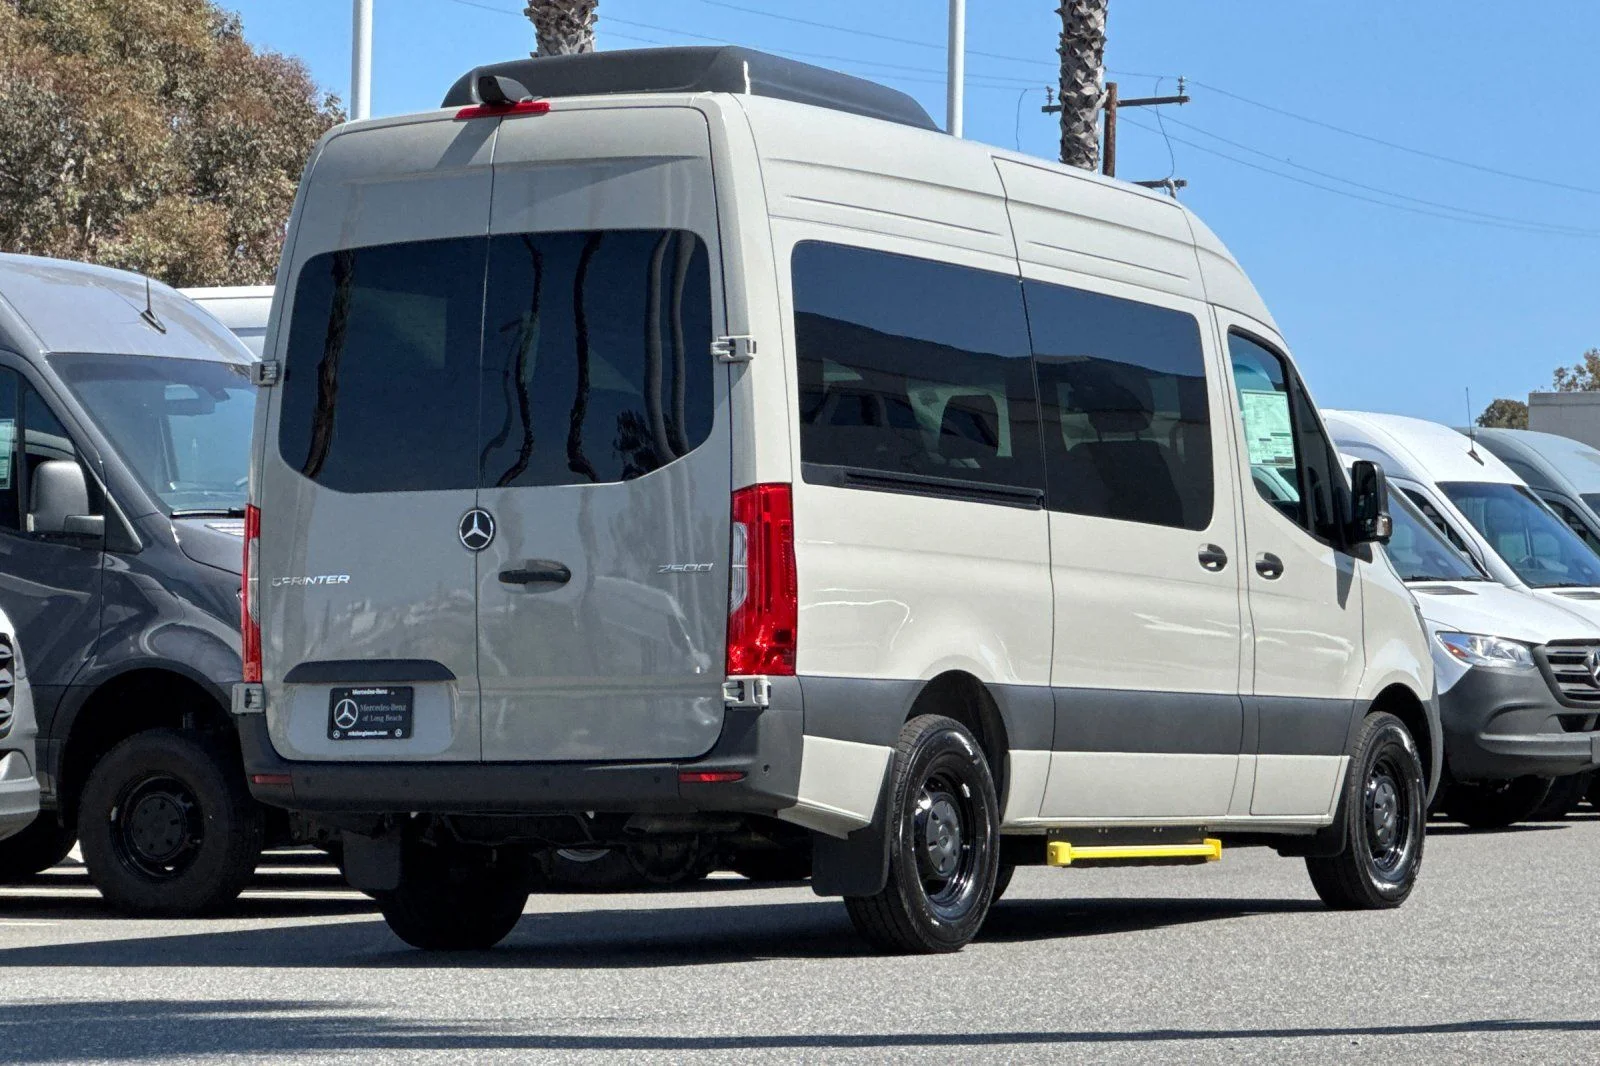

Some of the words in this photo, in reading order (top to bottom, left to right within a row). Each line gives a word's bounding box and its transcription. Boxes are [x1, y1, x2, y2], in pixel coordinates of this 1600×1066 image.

[657, 562, 714, 574] 2500
[271, 574, 351, 587] SPRINTER
[360, 703, 407, 712] Mercedes-Benz
